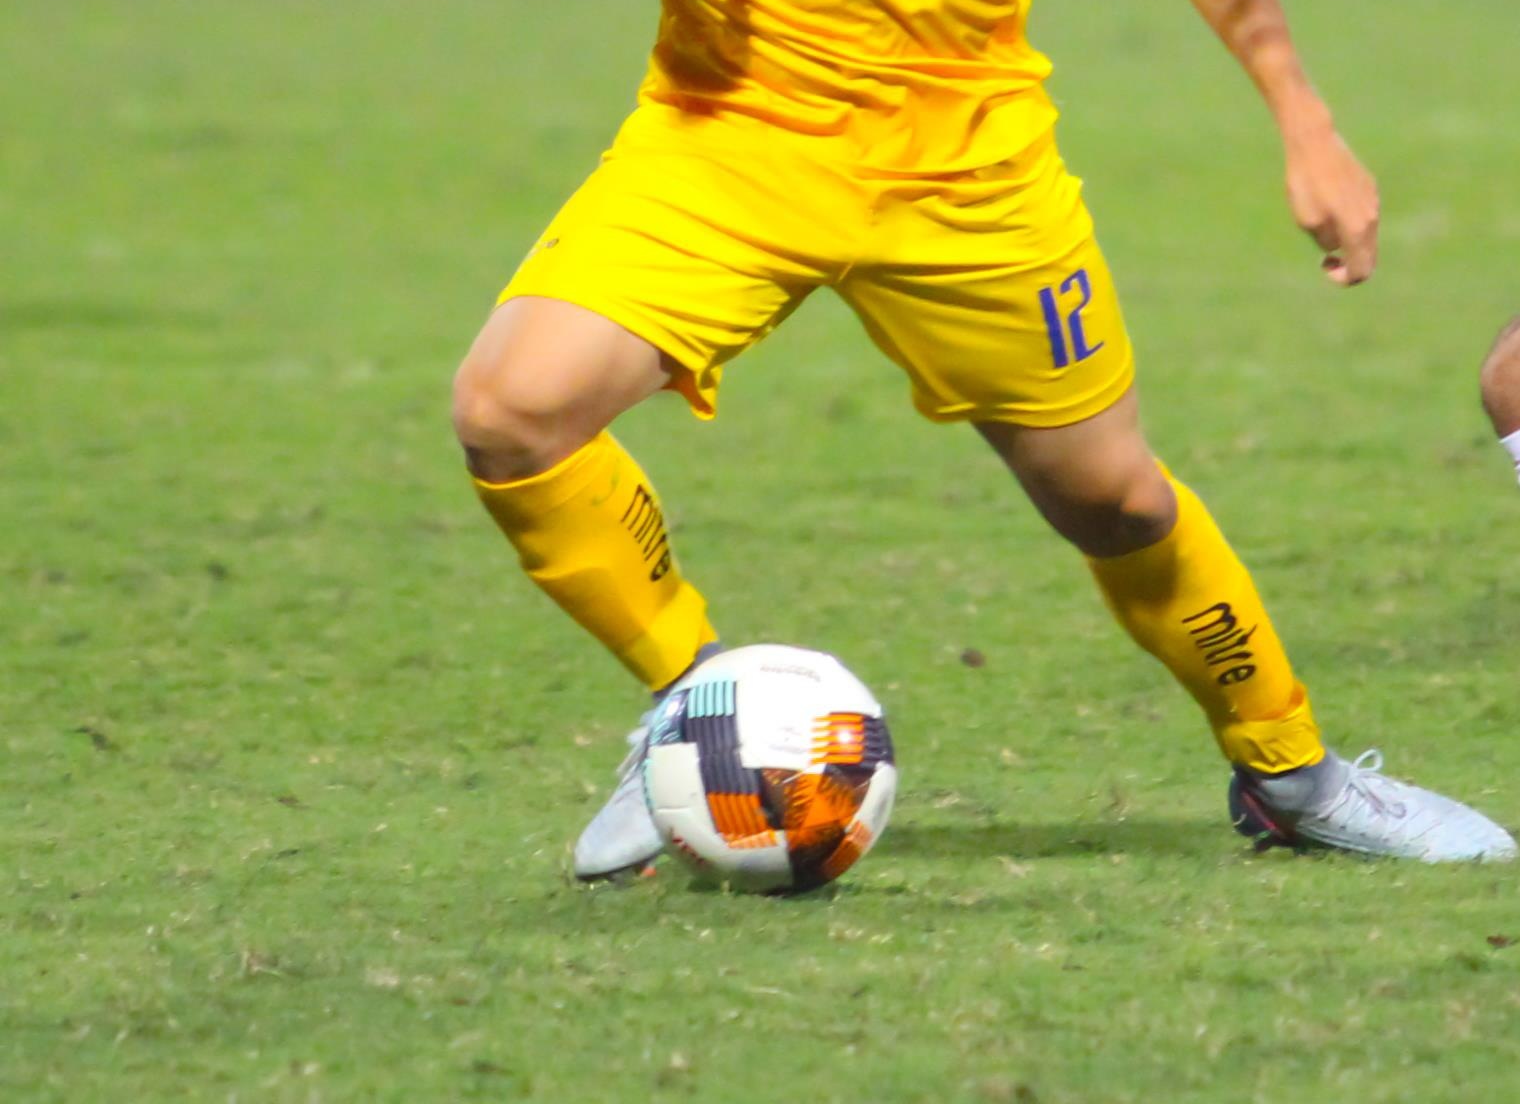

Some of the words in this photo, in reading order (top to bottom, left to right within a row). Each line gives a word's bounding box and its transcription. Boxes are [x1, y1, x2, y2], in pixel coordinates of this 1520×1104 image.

[1037, 267, 1105, 370] 12
[620, 483, 671, 582] mitre
[1181, 602, 1258, 685] mitre
